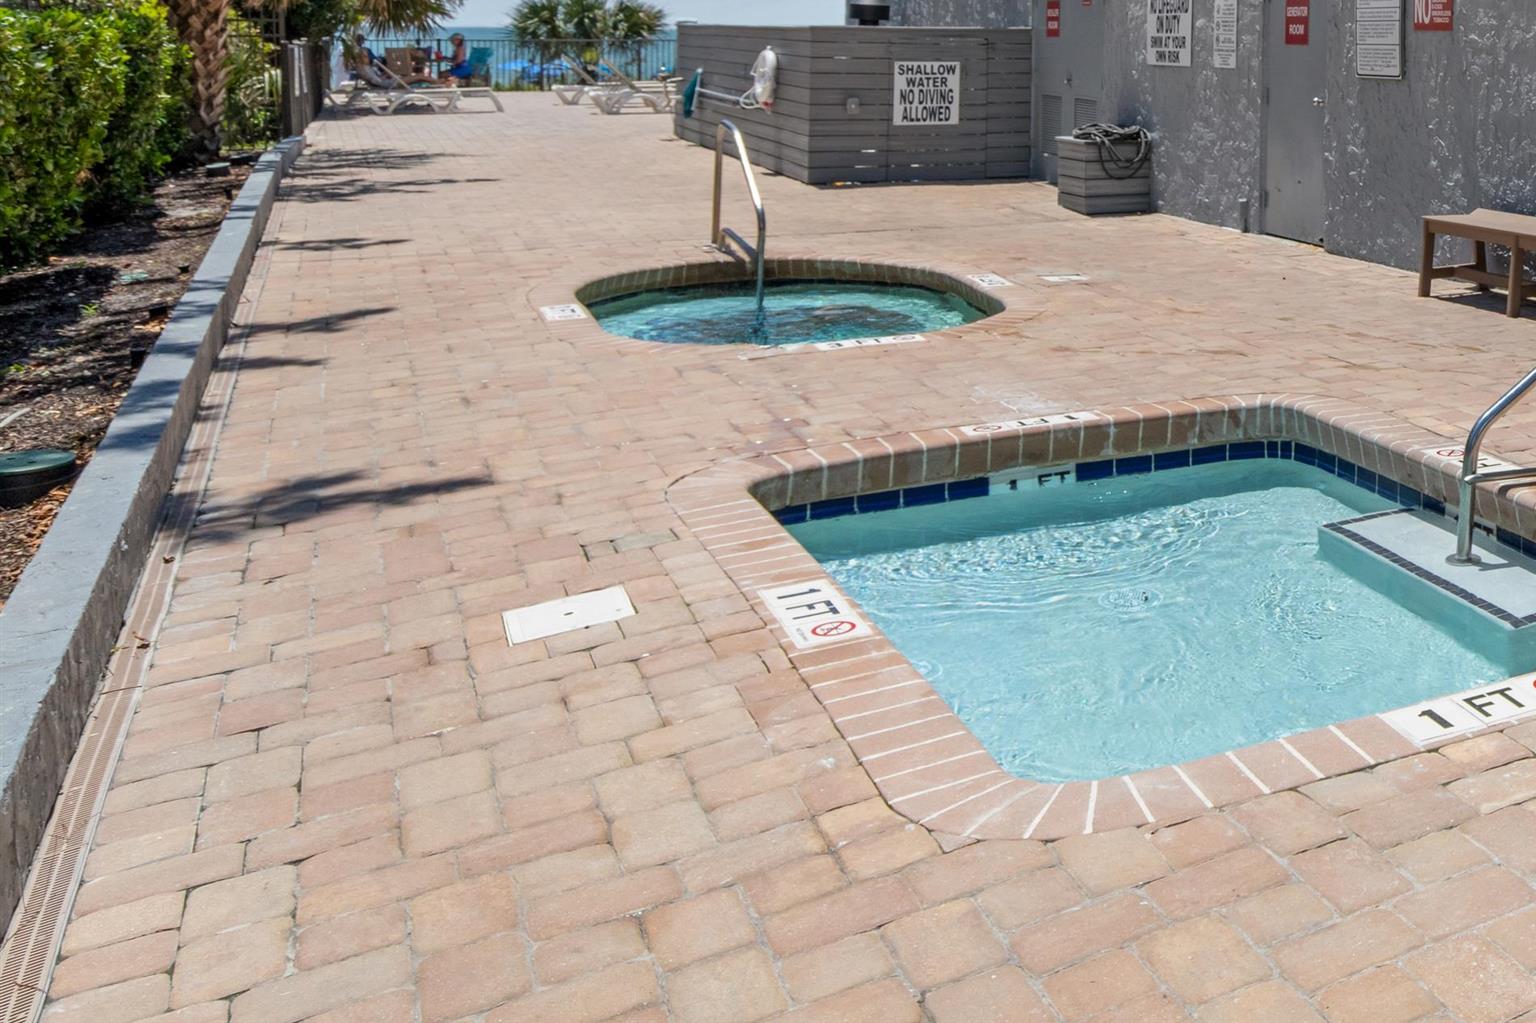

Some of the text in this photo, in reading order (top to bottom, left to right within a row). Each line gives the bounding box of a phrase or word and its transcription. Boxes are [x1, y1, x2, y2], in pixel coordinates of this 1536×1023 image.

[1156, 15, 1181, 34] ON DUTY
[1289, 23, 1304, 35] ROOM
[1150, 36, 1186, 49] SWIM AT YOUR
[1155, 50, 1181, 63] OWN RISK
[898, 64, 957, 76] SHALLOW
[906, 77, 948, 88] WATER
[899, 89, 954, 105] NO DIVING
[901, 106, 951, 122] ALLOWED
[777, 588, 840, 620] 1 FT
[1418, 686, 1525, 730] 1 FT
